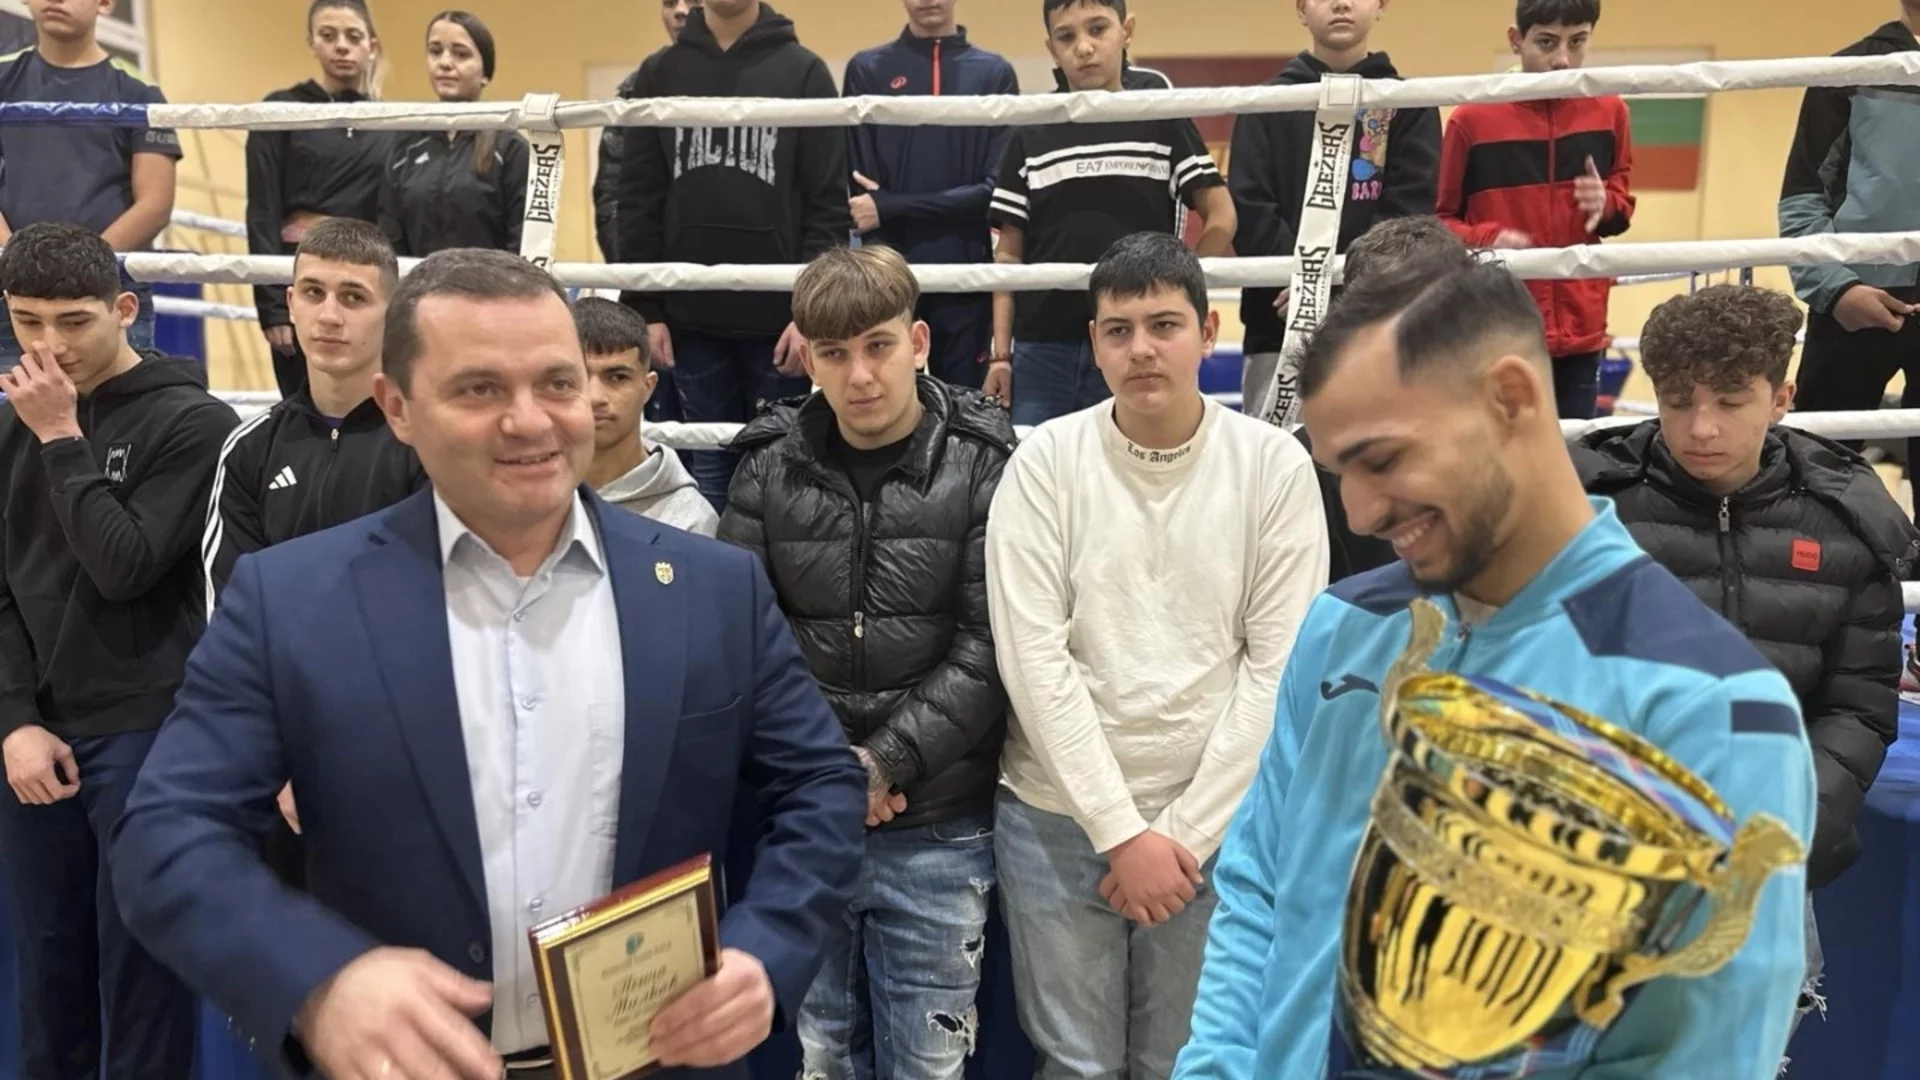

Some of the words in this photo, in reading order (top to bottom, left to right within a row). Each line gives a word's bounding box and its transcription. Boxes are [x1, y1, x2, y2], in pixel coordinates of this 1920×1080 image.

[525, 143, 562, 224] GEEZERS
[674, 126, 778, 187] FACTOR
[1076, 161, 1104, 174] EA7
[1305, 121, 1351, 210] GEEZERS
[1289, 245, 1332, 334] GEEZERS
[1127, 441, 1146, 460] Los
[1149, 444, 1191, 463] Angeles
